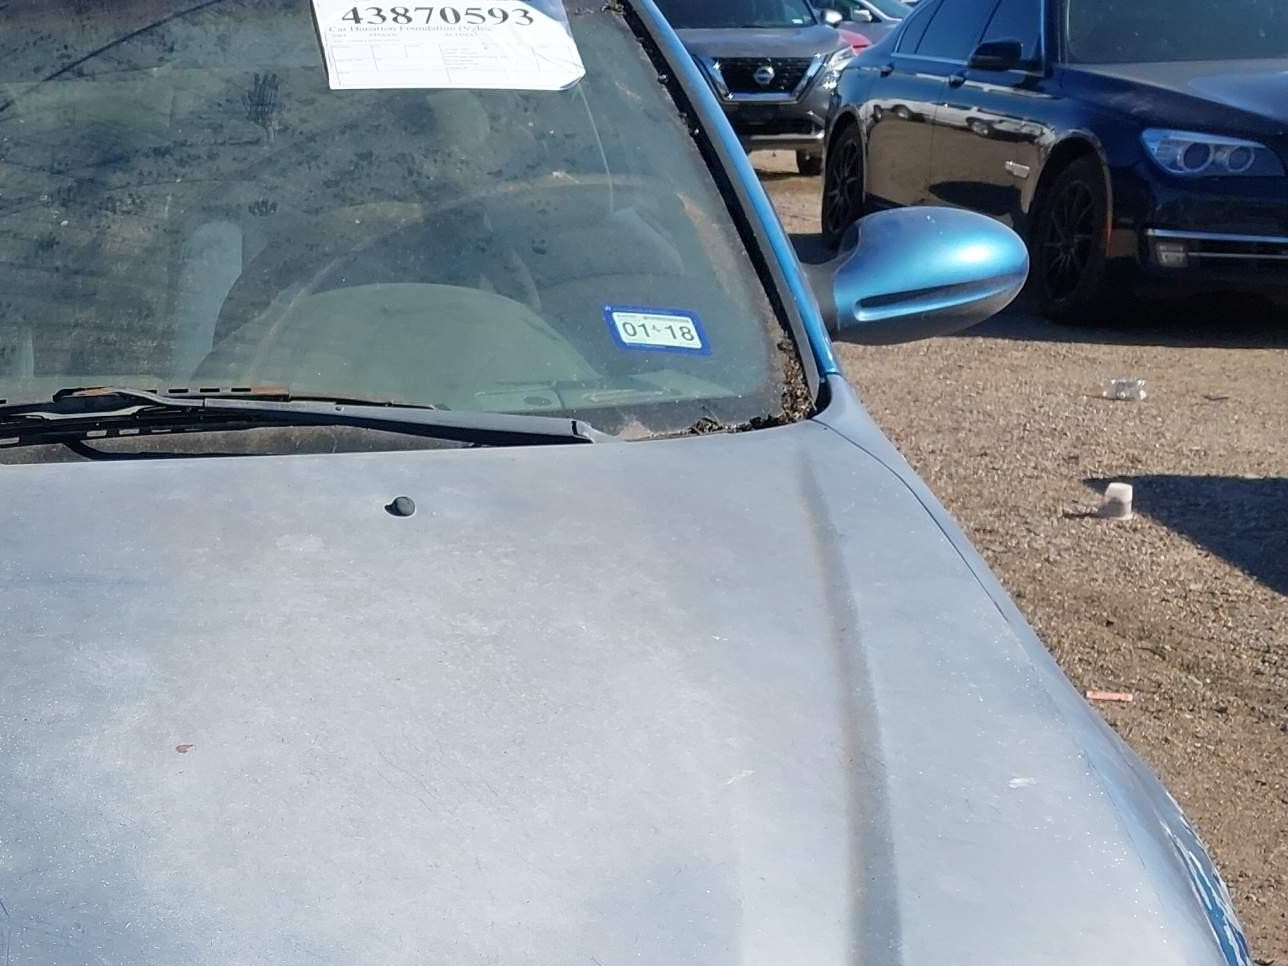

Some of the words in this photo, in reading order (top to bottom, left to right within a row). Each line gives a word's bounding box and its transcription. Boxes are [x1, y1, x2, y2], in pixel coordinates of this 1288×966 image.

[342, 6, 534, 25] 43870593
[622, 322, 650, 337] 01
[664, 325, 695, 341] 18
